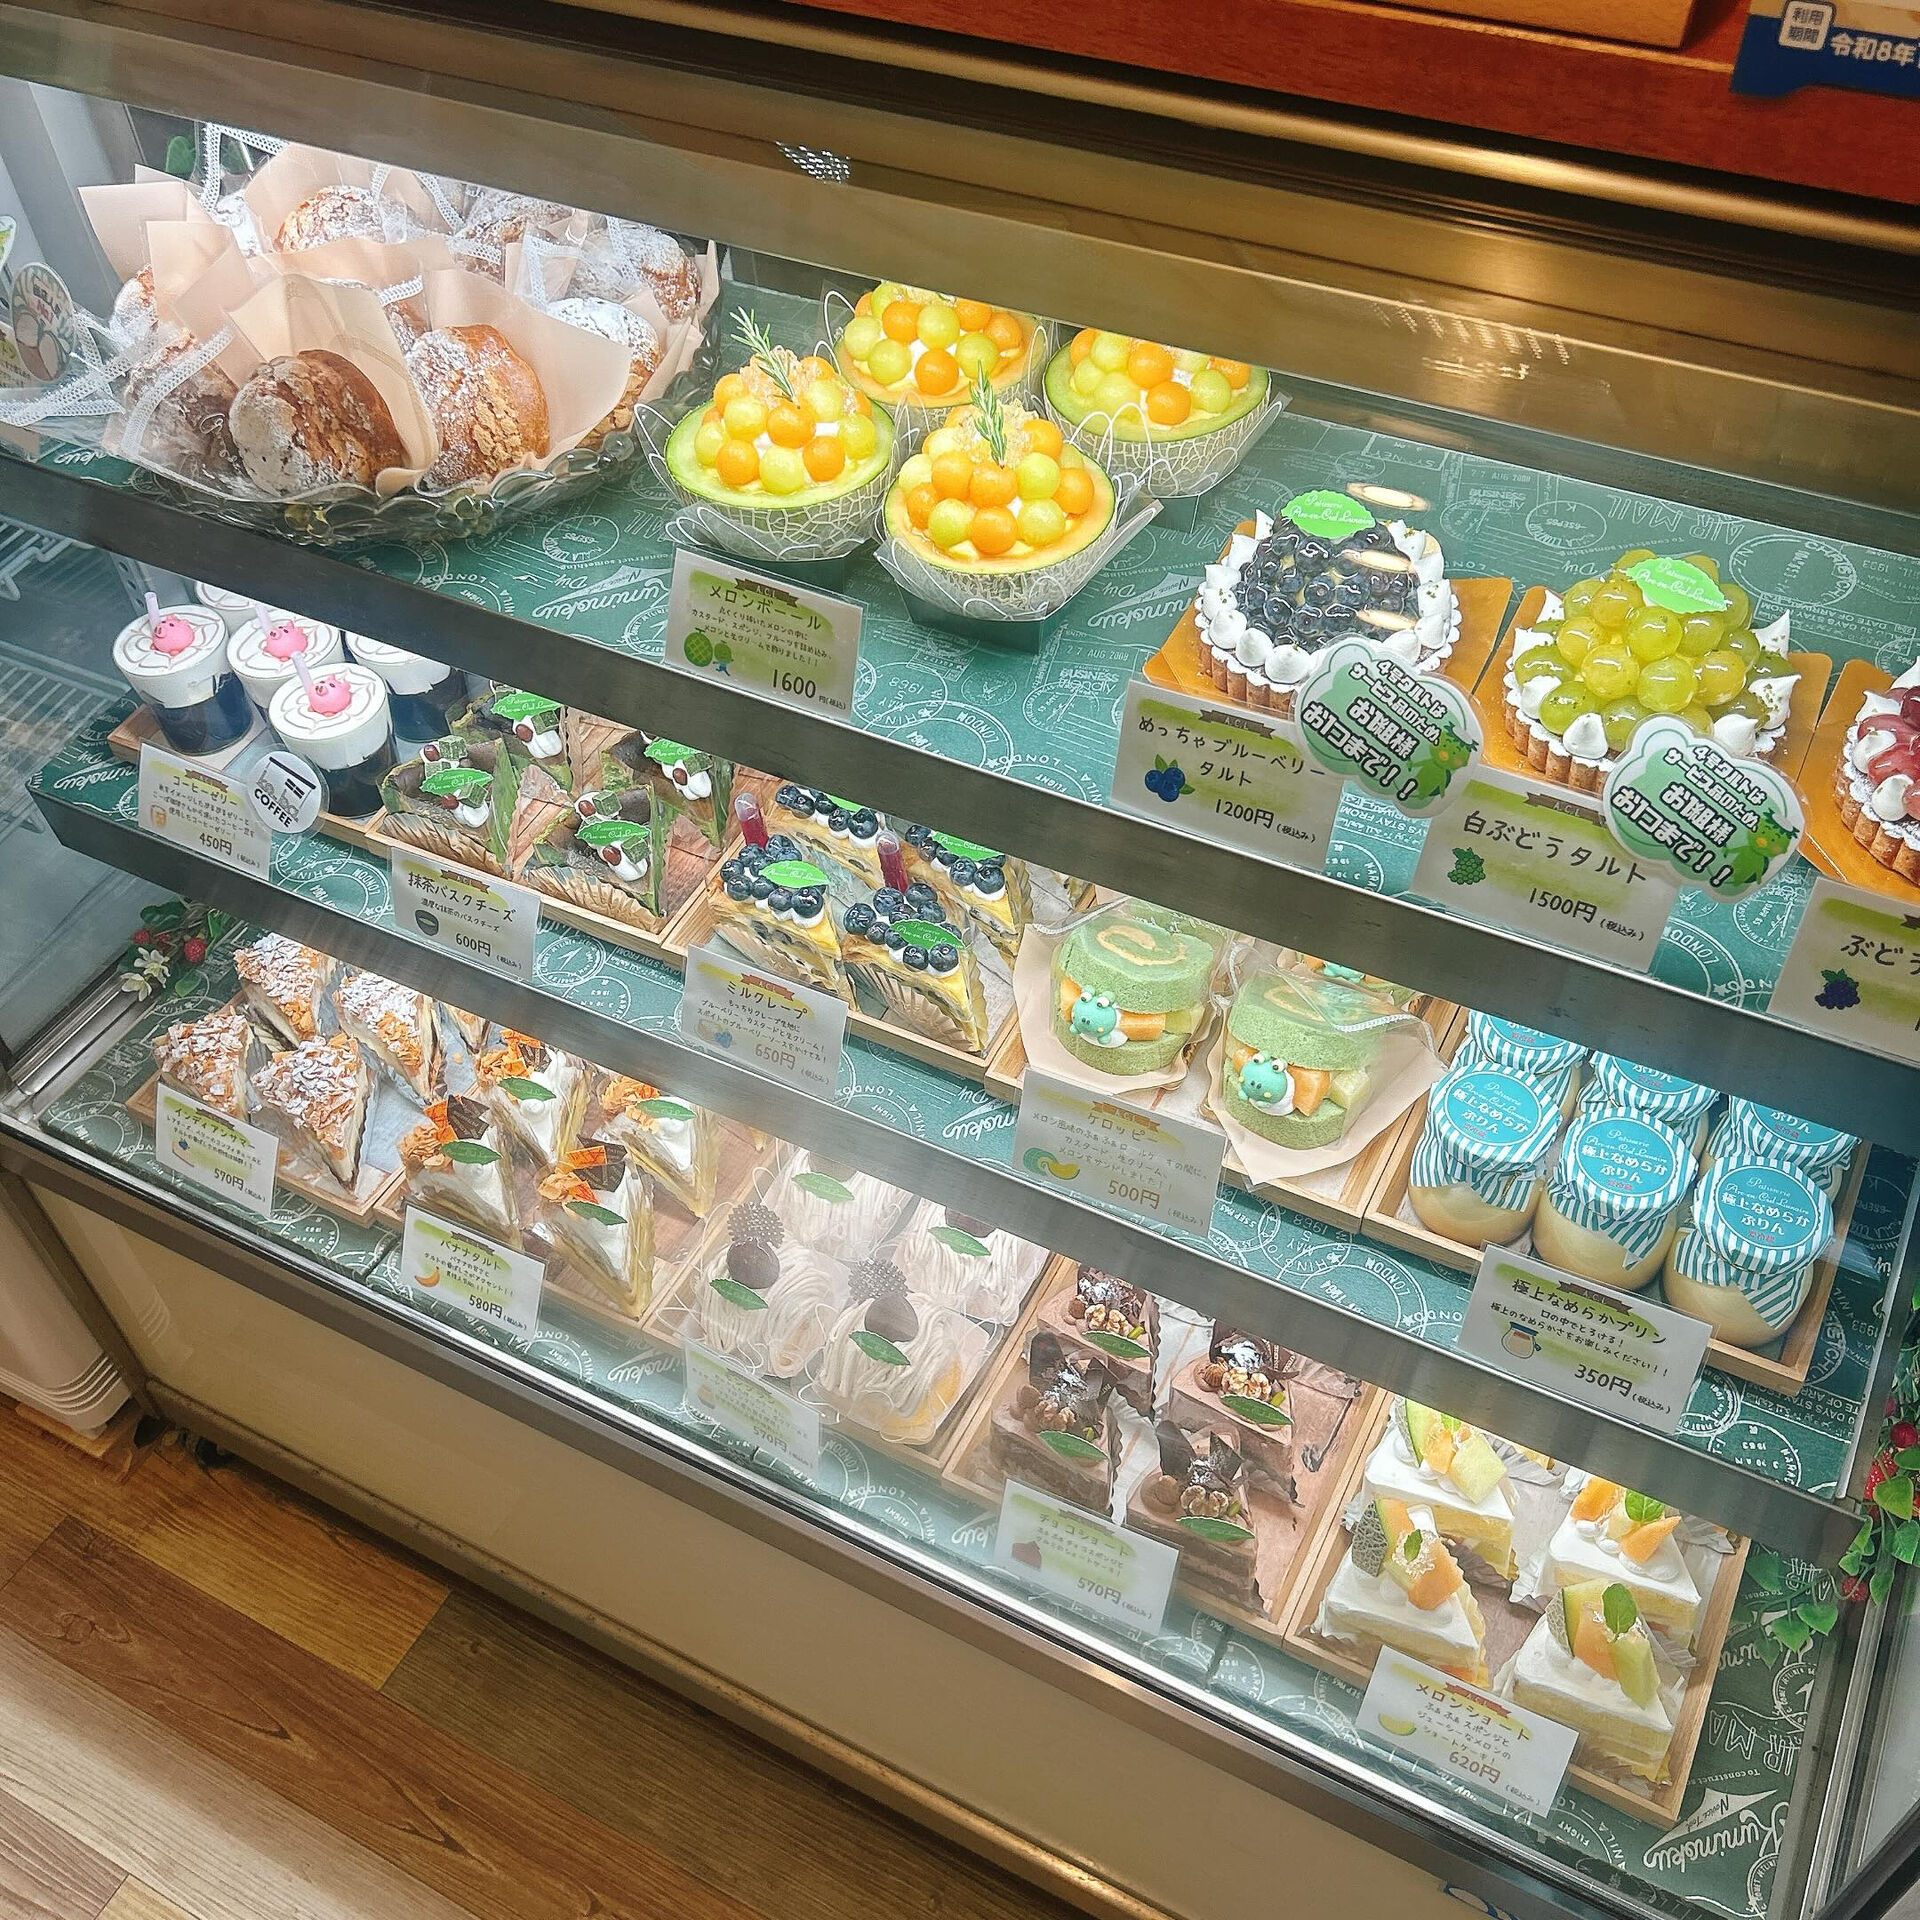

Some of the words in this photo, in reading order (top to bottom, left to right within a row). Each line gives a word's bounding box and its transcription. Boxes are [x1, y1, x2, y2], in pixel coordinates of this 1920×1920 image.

[1793, 7, 1825, 26] 利用
[1788, 26, 1820, 44] 期間
[1830, 31, 1920, 67] 令和8年
[1606, 494, 1684, 532] MAIL
[772, 668, 817, 699] 1600
[1376, 659, 1448, 721] 4号タルトは
[1349, 661, 1443, 747] サービス品のため、
[1346, 696, 1421, 762] お1組様
[1137, 716, 1326, 777] めっちゃブルーベリー
[172, 775, 239, 807] コーヒーゼリー
[1198, 760, 1253, 788] タルト
[1662, 747, 1761, 833] サービス品のため、
[1692, 744, 1768, 806] 4号タルトは
[253, 787, 294, 829] COFFEE
[1215, 798, 1275, 829] 1200円
[1659, 781, 1737, 848] お1組様
[198, 832, 233, 857] 450円
[1462, 809, 1648, 885] 白ぶどうタルト
[407, 871, 518, 923] 抹茶バスクチーズ
[1527, 887, 1598, 924] 1500円
[455, 932, 492, 958] 600円
[726, 980, 809, 1020] ミルクレープ
[754, 1043, 797, 1071] 650円
[942, 1112, 1016, 1142] moku
[1087, 1112, 1159, 1144] ケロッピー
[1461, 1109, 1499, 1135] ぷりん
[1580, 1143, 1669, 1176] 極上なめらか
[1599, 1163, 1644, 1185] ぷりん
[213, 1167, 245, 1192] 570円
[1108, 1179, 1161, 1211] 500円
[1721, 1190, 1812, 1229] 極上なめらか
[1740, 1213, 1786, 1236] ぷりん
[440, 1239, 502, 1271] バナナタルト
[468, 1294, 504, 1319] 580円
[1510, 1277, 1668, 1345] 極上なめらかプリン
[1573, 1363, 1634, 1398] 350円
[1038, 1513, 1130, 1558] チョコショート
[1076, 1576, 1122, 1604] 570円
[1415, 1682, 1531, 1742] メロンショート
[1448, 1750, 1502, 1786] 620円
